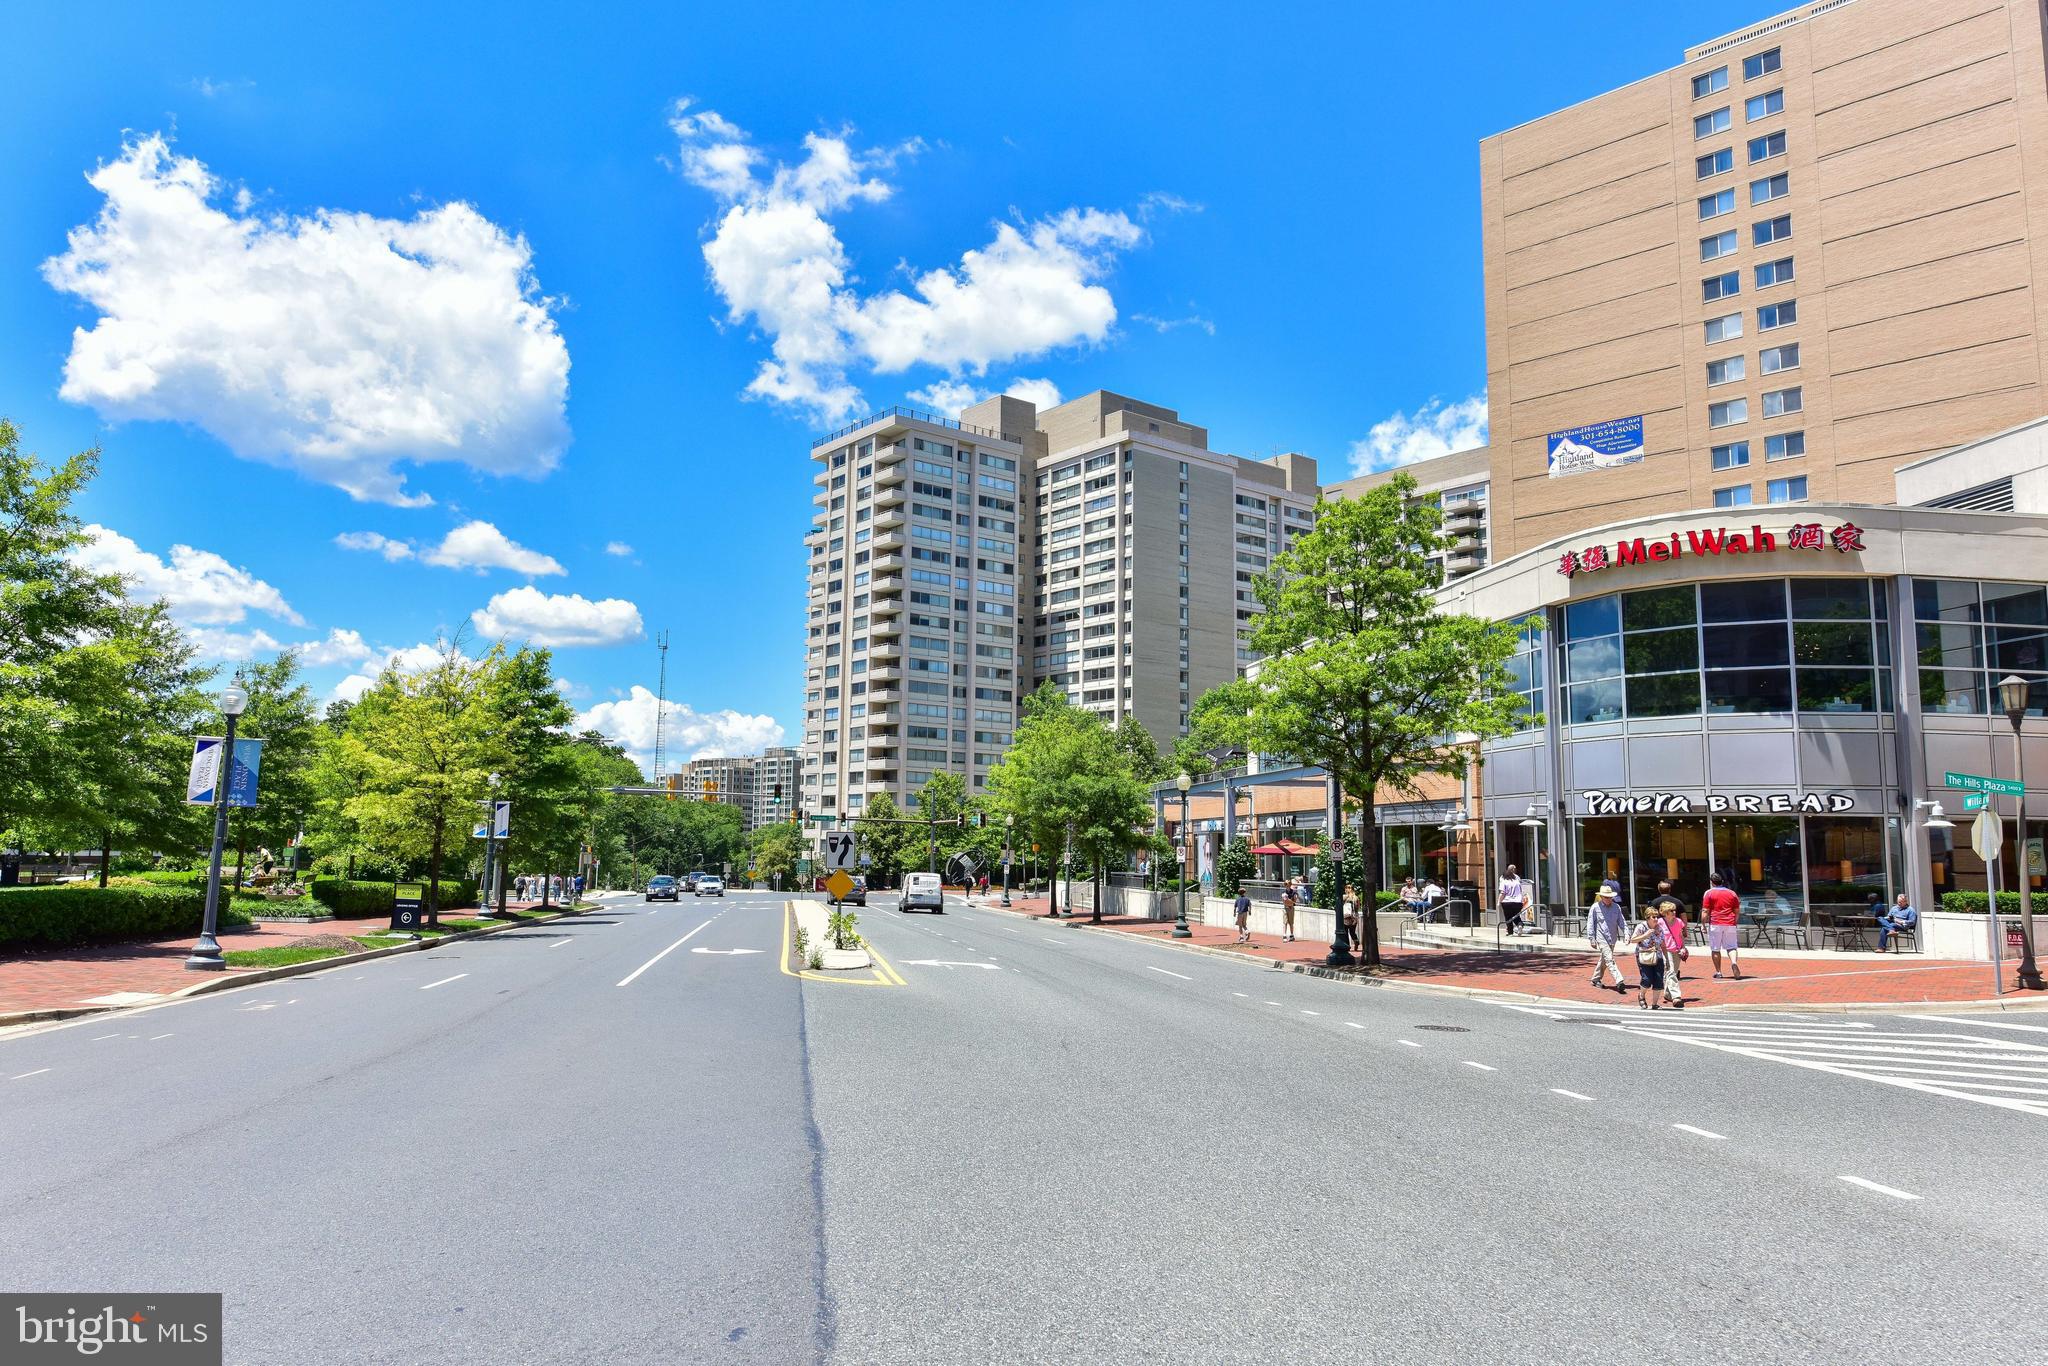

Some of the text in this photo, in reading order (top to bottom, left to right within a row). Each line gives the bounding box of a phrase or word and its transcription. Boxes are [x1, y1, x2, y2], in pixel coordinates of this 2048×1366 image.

[1550, 417, 1640, 439] HighlandHouseWest.net
[1580, 423, 1640, 441] 301-654-8000
[1559, 451, 1594, 465] Highland
[1580, 459, 1595, 467] West
[1616, 525, 1776, 568] Mei Wah
[1788, 522, 1866, 553] 酒家
[234, 766, 242, 790] PLACE
[241, 745, 250, 791] WISCONSIN
[1948, 775, 1961, 786] The
[1964, 777, 1981, 789] Hills
[1984, 780, 2006, 792] Plaza
[1582, 790, 1855, 816] Panera BREAD
